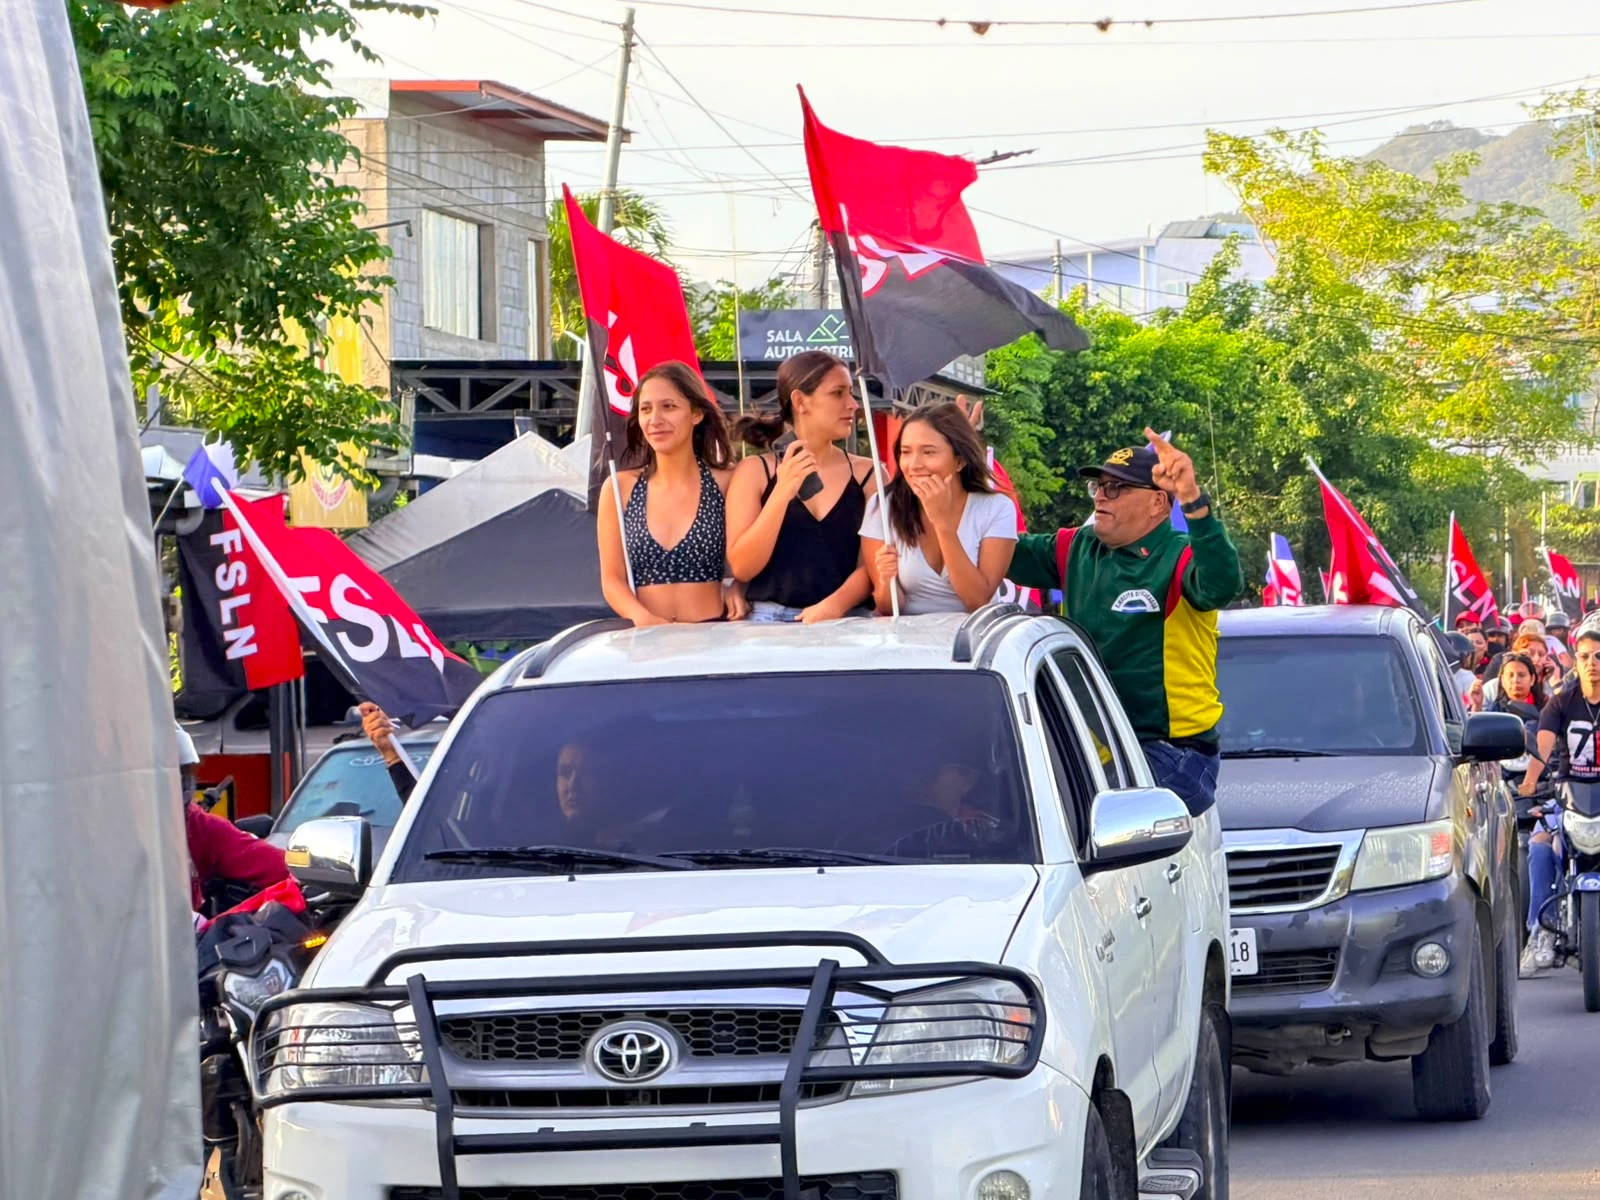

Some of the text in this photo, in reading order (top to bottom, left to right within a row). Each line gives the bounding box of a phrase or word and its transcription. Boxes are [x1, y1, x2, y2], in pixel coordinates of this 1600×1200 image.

[767, 330, 803, 342] SALA
[210, 528, 258, 660] FSLN
[1450, 558, 1497, 622] SLN
